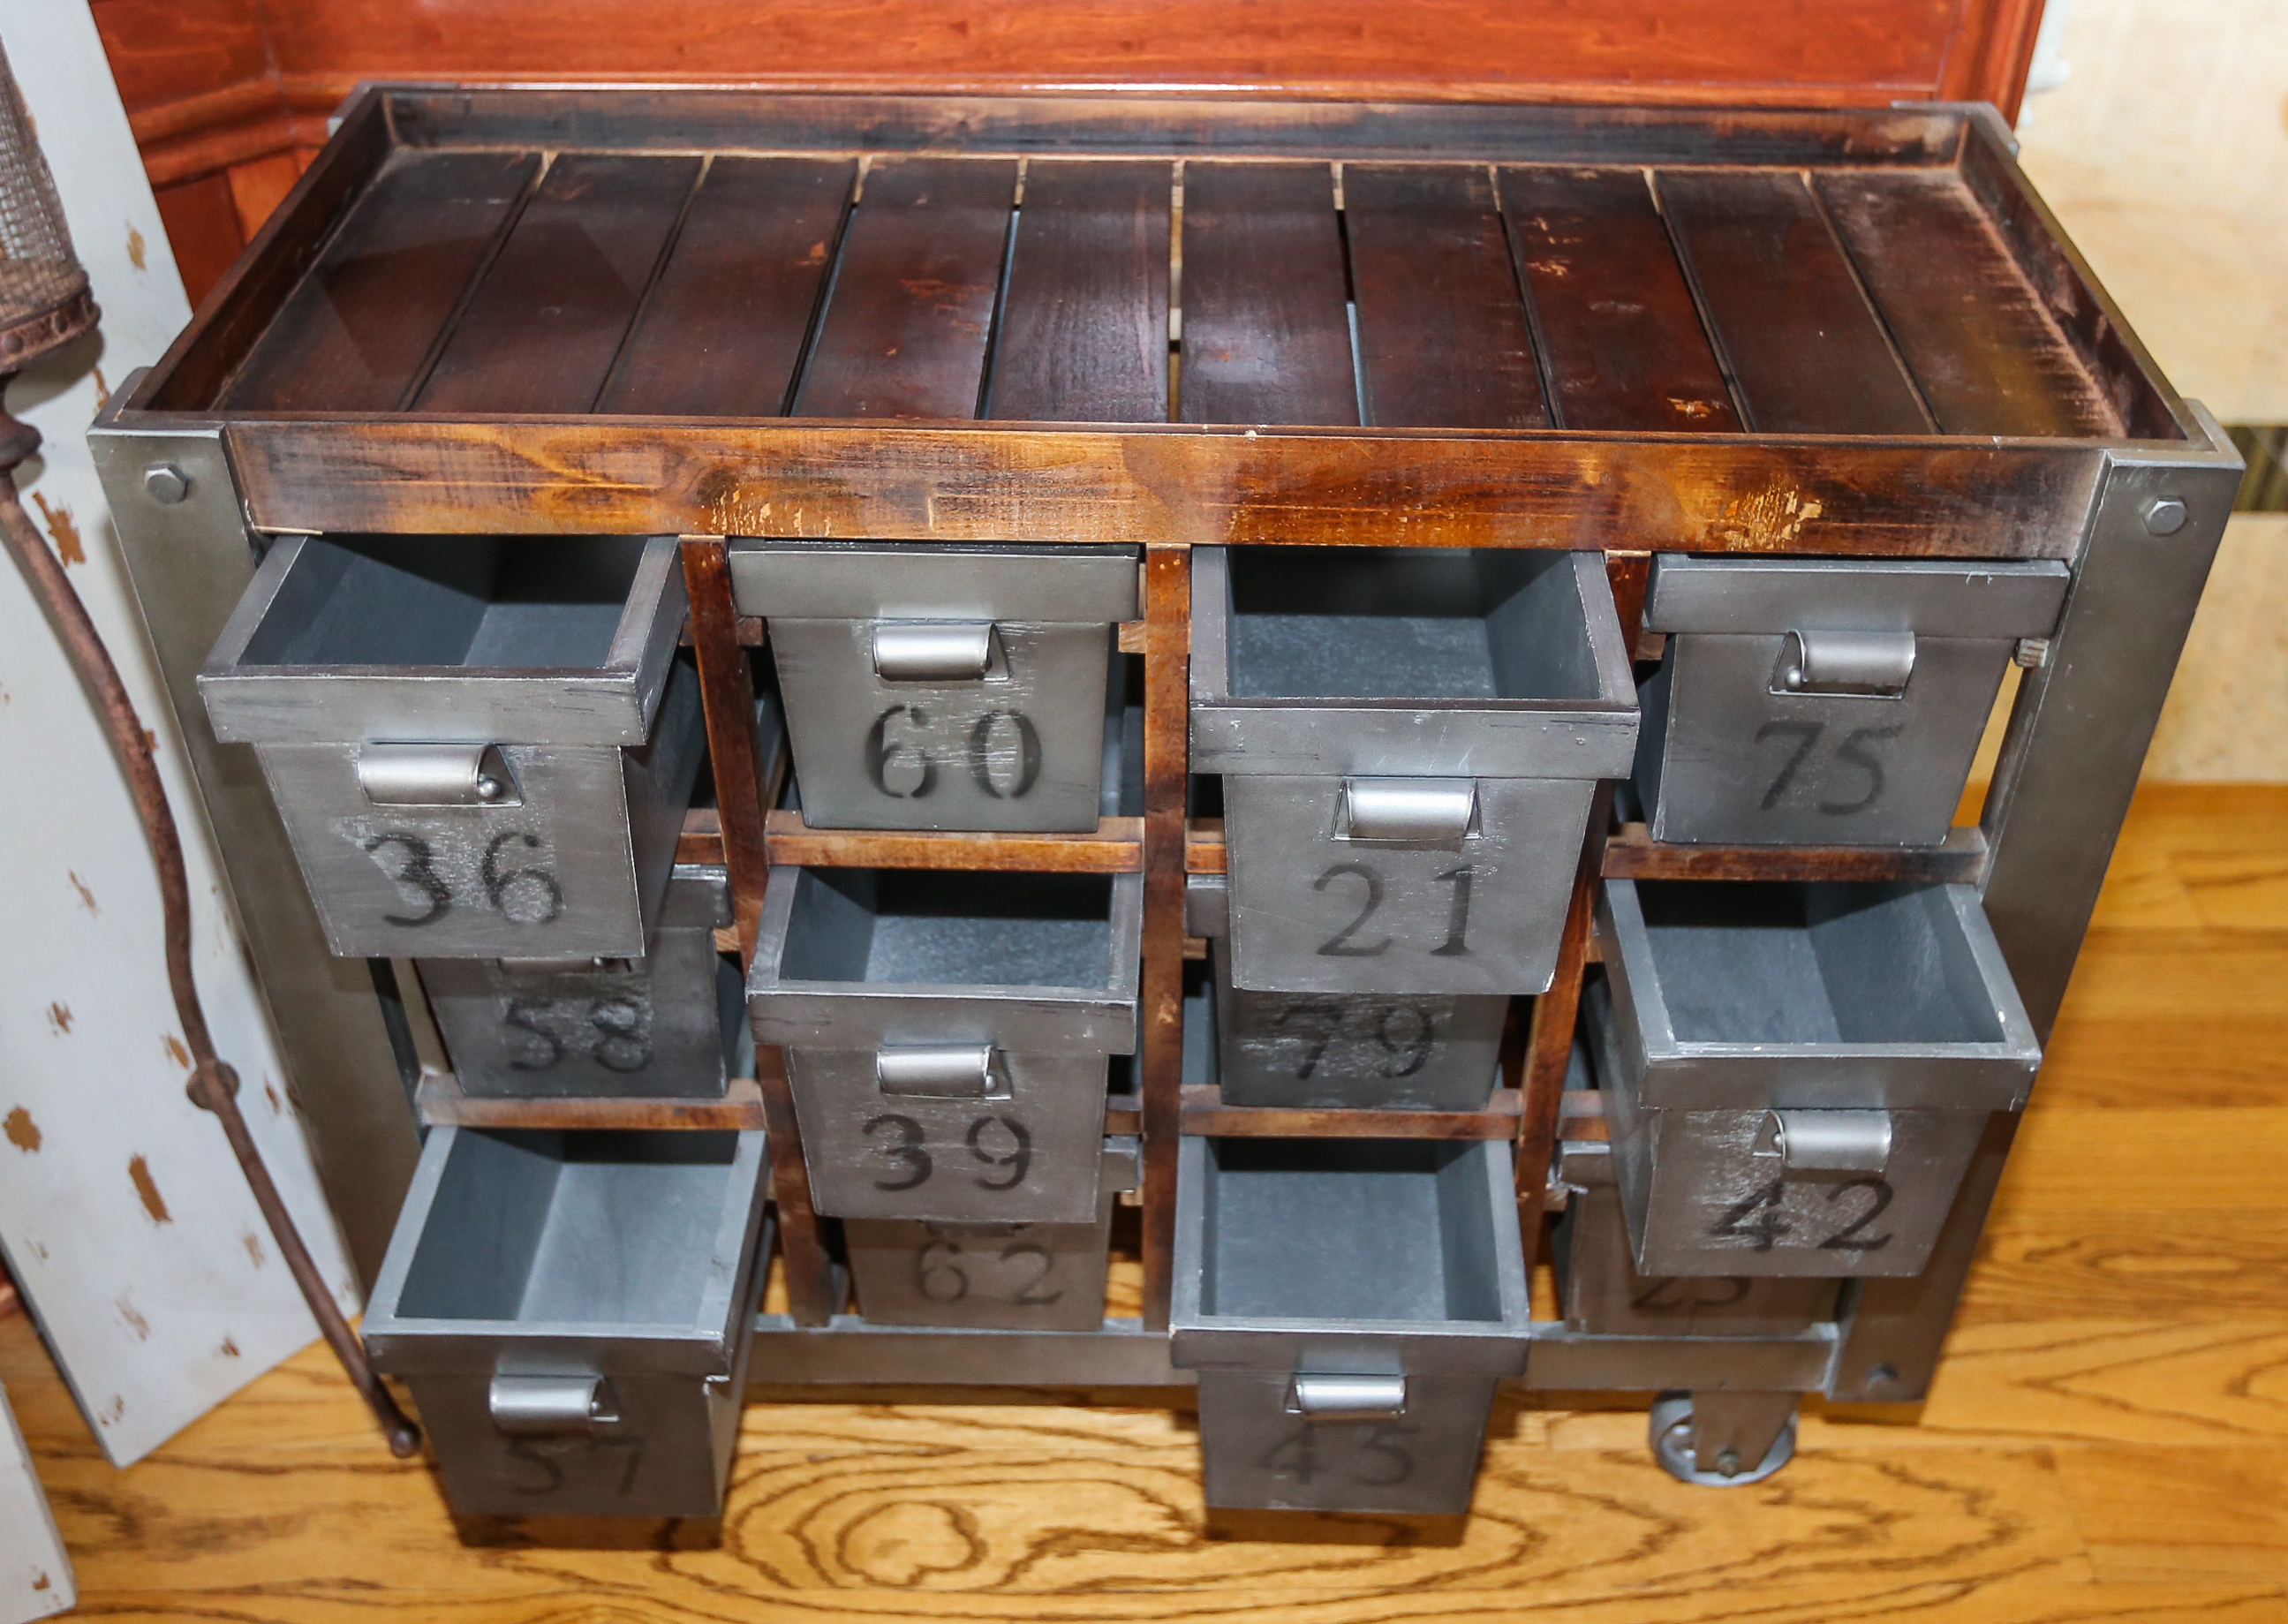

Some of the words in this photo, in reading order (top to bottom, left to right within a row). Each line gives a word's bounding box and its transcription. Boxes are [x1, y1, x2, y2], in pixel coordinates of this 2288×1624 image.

[865, 705, 1041, 798] 60
[1754, 720, 1905, 815] 75
[363, 830, 564, 926] 36
[1314, 862, 1474, 956] 21
[506, 995, 652, 1072] 58
[1277, 1004, 1433, 1079] 79
[861, 1114, 1031, 1191] 39
[1710, 1177, 1893, 1251] 42
[915, 1241, 1062, 1305] 62
[507, 1435, 643, 1495] 57
[1254, 1424, 1420, 1486] 45
